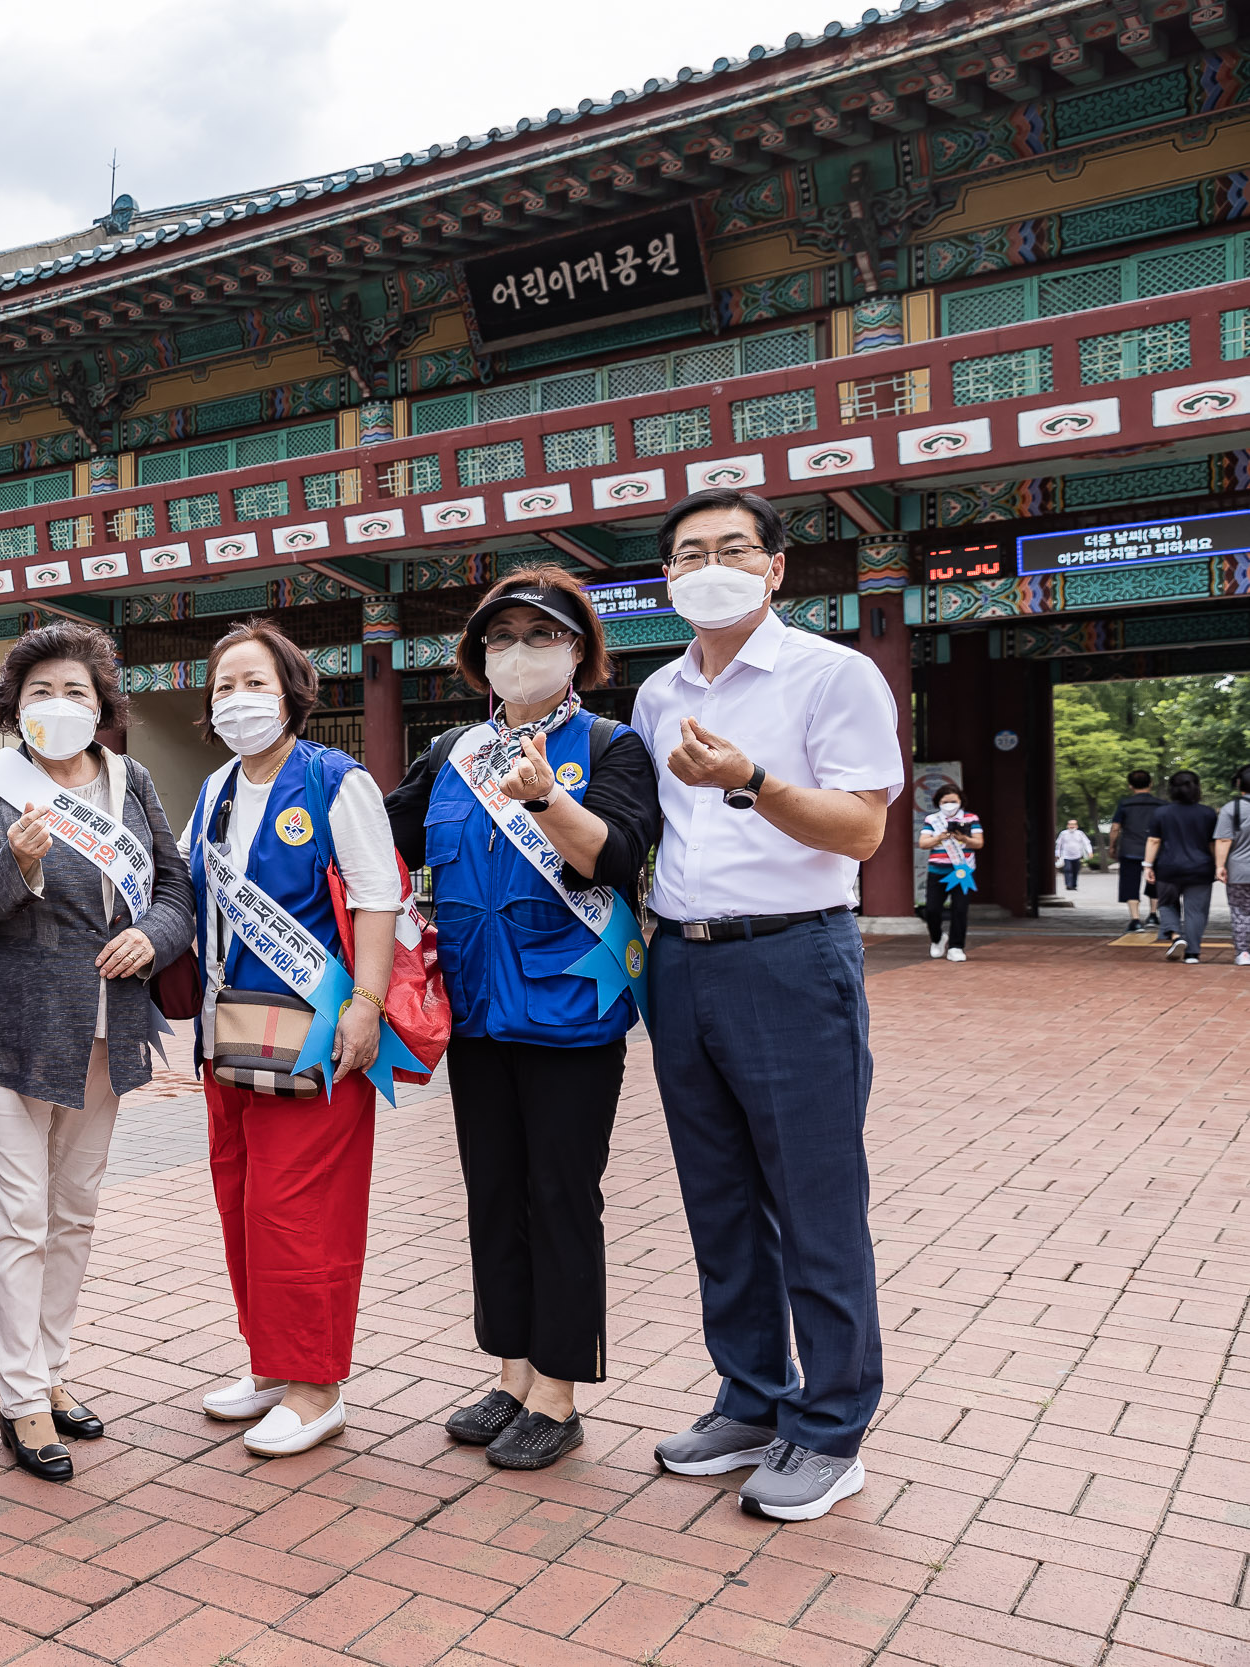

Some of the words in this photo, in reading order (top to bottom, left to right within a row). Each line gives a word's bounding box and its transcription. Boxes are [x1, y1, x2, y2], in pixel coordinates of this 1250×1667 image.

[491, 232, 680, 310] 어린이대공원
[1057, 543, 1152, 566] 이기려하지말고
[1154, 537, 1214, 555] 피하세요
[1084, 533, 1113, 549] 더운
[1114, 524, 1183, 545] 날씨(폭염)
[618, 597, 658, 611] 피하세요
[44, 810, 116, 865] 코로나19
[53, 794, 112, 835] 여름철
[115, 834, 147, 872] 행락
[234, 875, 326, 970] 질서지키기
